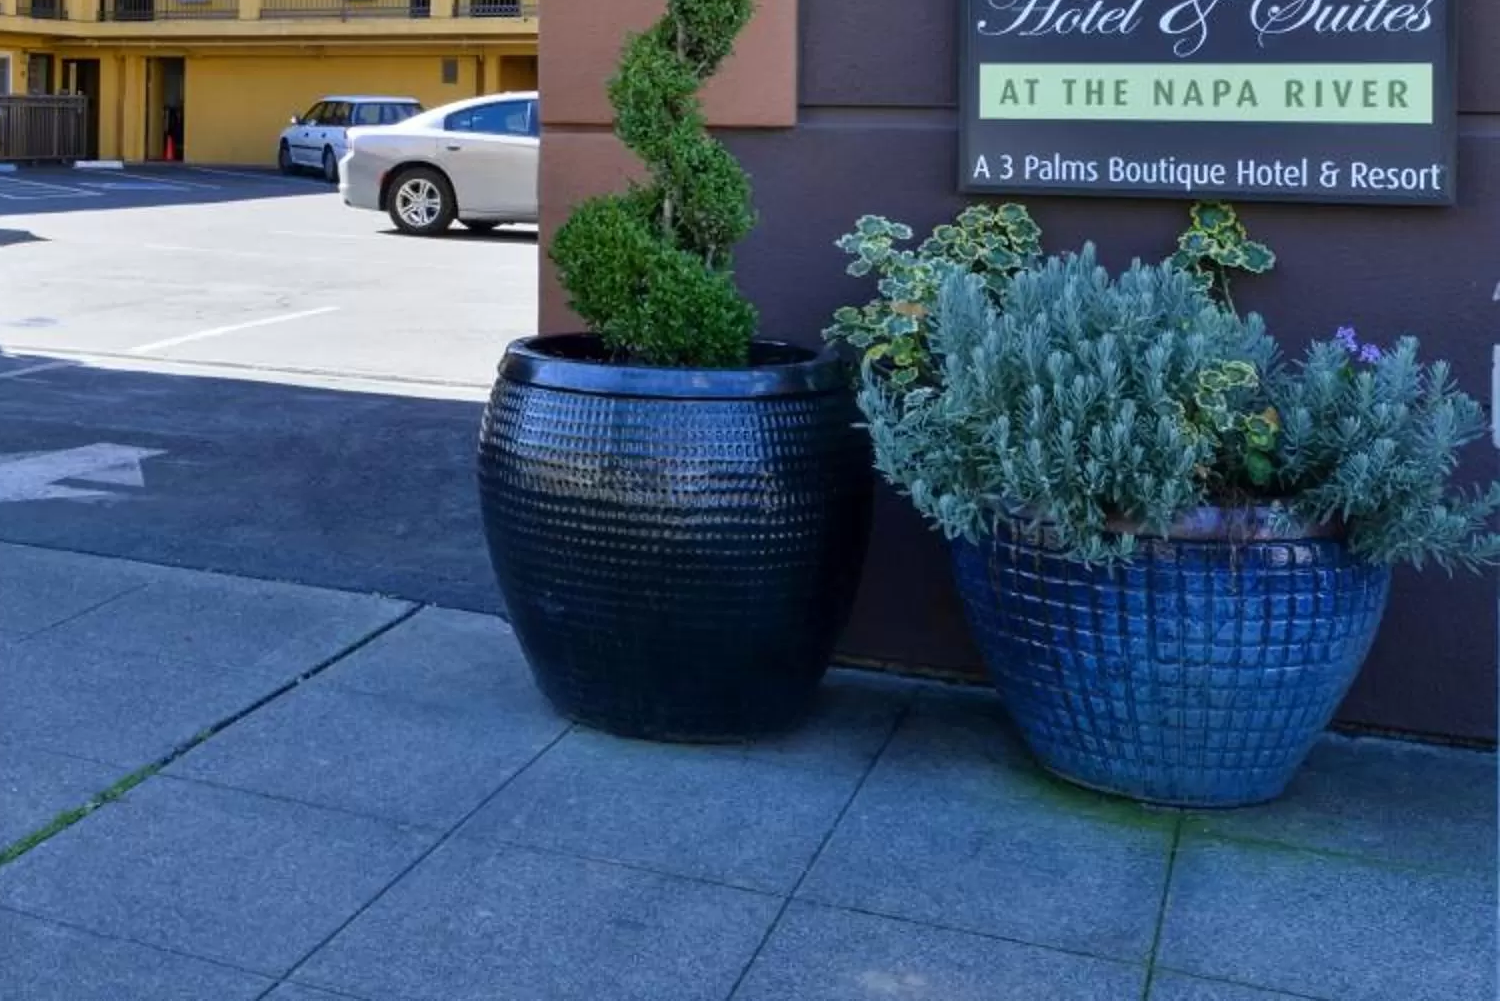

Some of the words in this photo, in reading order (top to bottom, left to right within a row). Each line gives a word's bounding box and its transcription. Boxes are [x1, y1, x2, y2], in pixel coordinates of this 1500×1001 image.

[1000, 79, 1040, 105] AT
[1061, 79, 1128, 106] THE
[1153, 79, 1258, 108] NAPA
[1284, 80, 1409, 109] RIVER
[973, 155, 990, 179] A
[1000, 155, 1014, 179] 3
[1024, 153, 1098, 182] Palms
[1108, 156, 1227, 191] Boutique
[1237, 159, 1308, 187] Hotel
[1319, 162, 1340, 187] &
[1350, 162, 1441, 190] Resort
